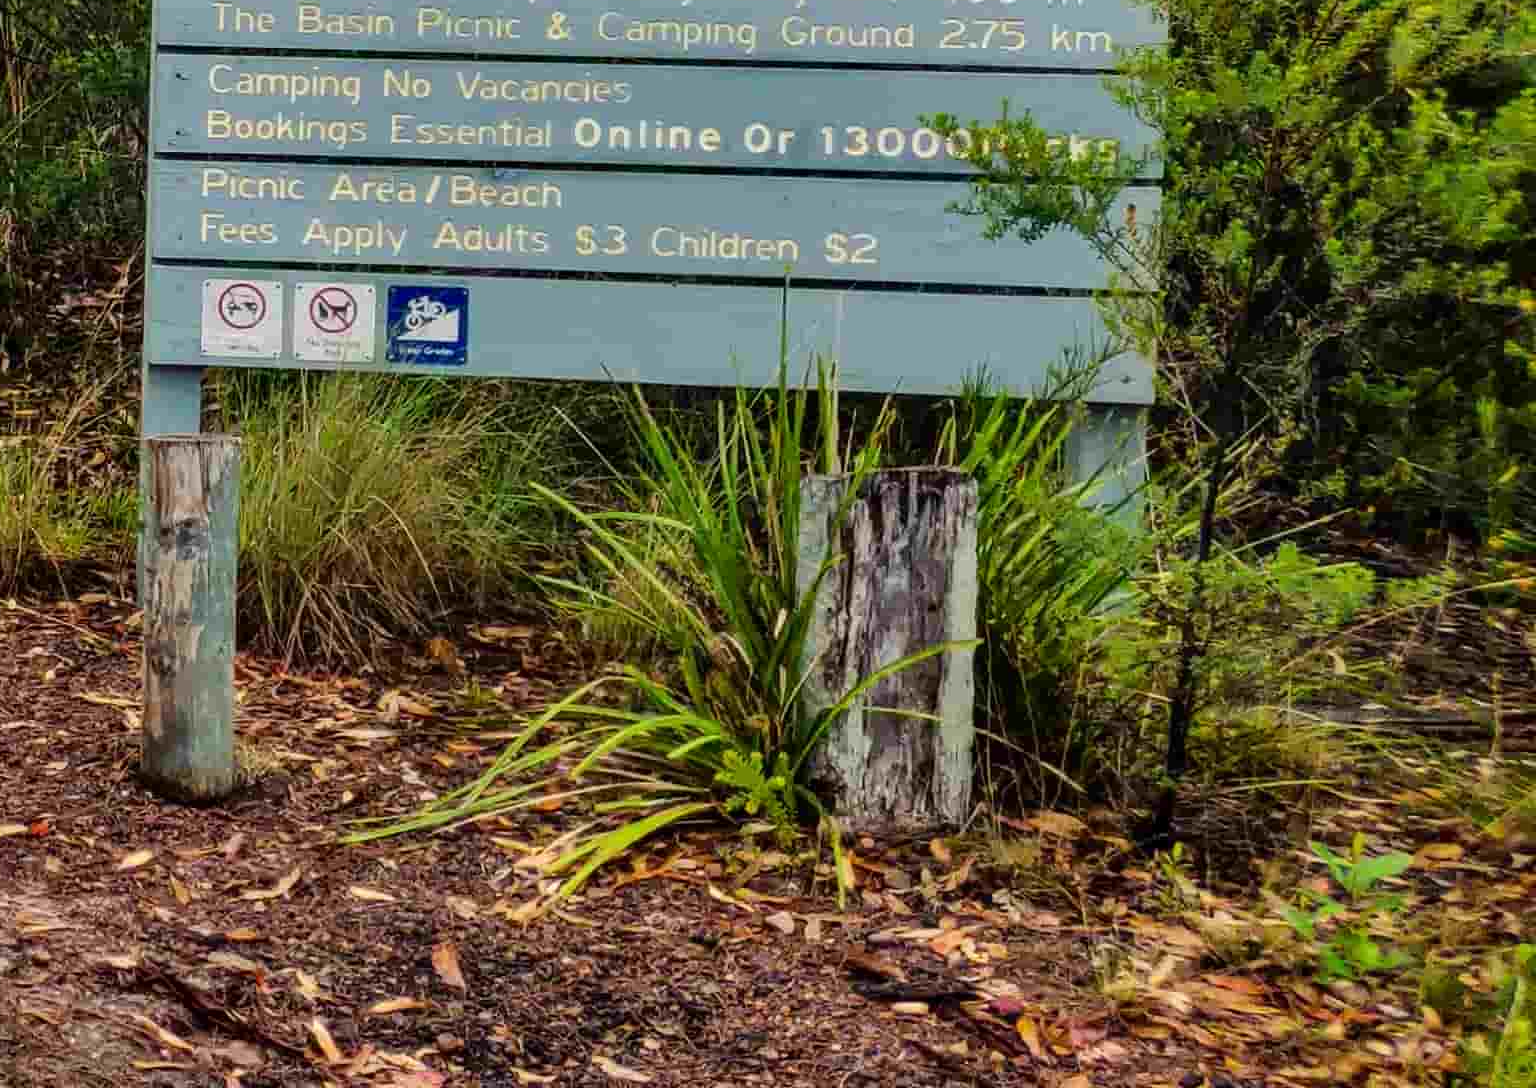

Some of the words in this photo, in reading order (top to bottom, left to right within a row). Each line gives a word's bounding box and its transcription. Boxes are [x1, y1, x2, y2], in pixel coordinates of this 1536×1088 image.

[210, 1, 275, 34] The
[297, 2, 396, 36] Basin
[417, 7, 522, 40] Picnic
[544, 11, 571, 41] &
[598, 12, 757, 54] Camping
[780, 15, 914, 50] Ground
[938, 18, 1026, 51] 2.75
[1050, 23, 1113, 54] km
[207, 63, 361, 104] Camping
[382, 68, 432, 99] No
[456, 70, 633, 104] Vacancies
[206, 109, 369, 151] Bookings
[390, 114, 553, 147] Essential
[574, 117, 722, 151] Online
[743, 121, 796, 155] Or
[199, 168, 306, 201] Picnic
[329, 172, 564, 209] Area/Beach
[199, 212, 278, 244] Fees
[302, 217, 409, 256] Apply
[432, 216, 550, 254] Adults
[575, 224, 628, 256] $3
[650, 225, 800, 263] Children
[824, 232, 881, 265] $2
